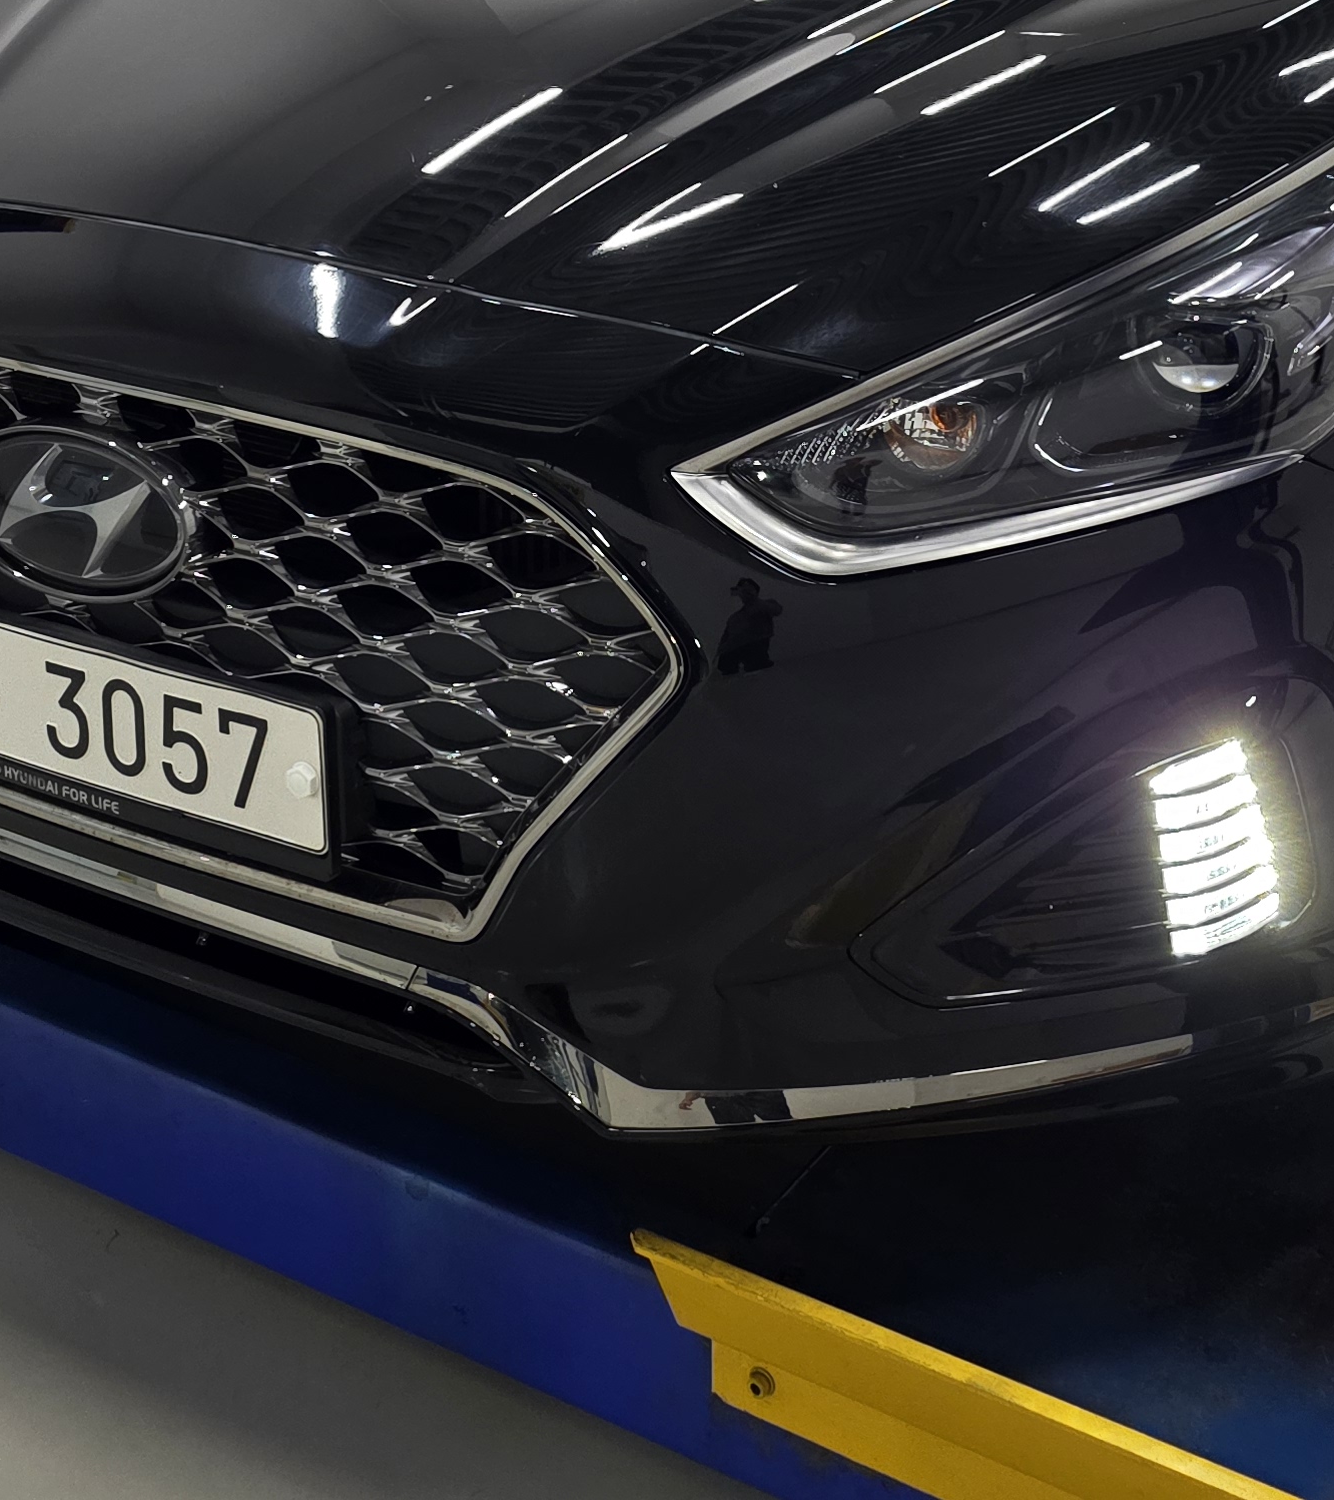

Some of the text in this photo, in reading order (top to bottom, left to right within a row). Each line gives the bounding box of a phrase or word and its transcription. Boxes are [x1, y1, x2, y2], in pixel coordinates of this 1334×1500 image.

[44, 660, 269, 809] 3057
[4, 765, 120, 815] HYUNDAI FOR LIFE
